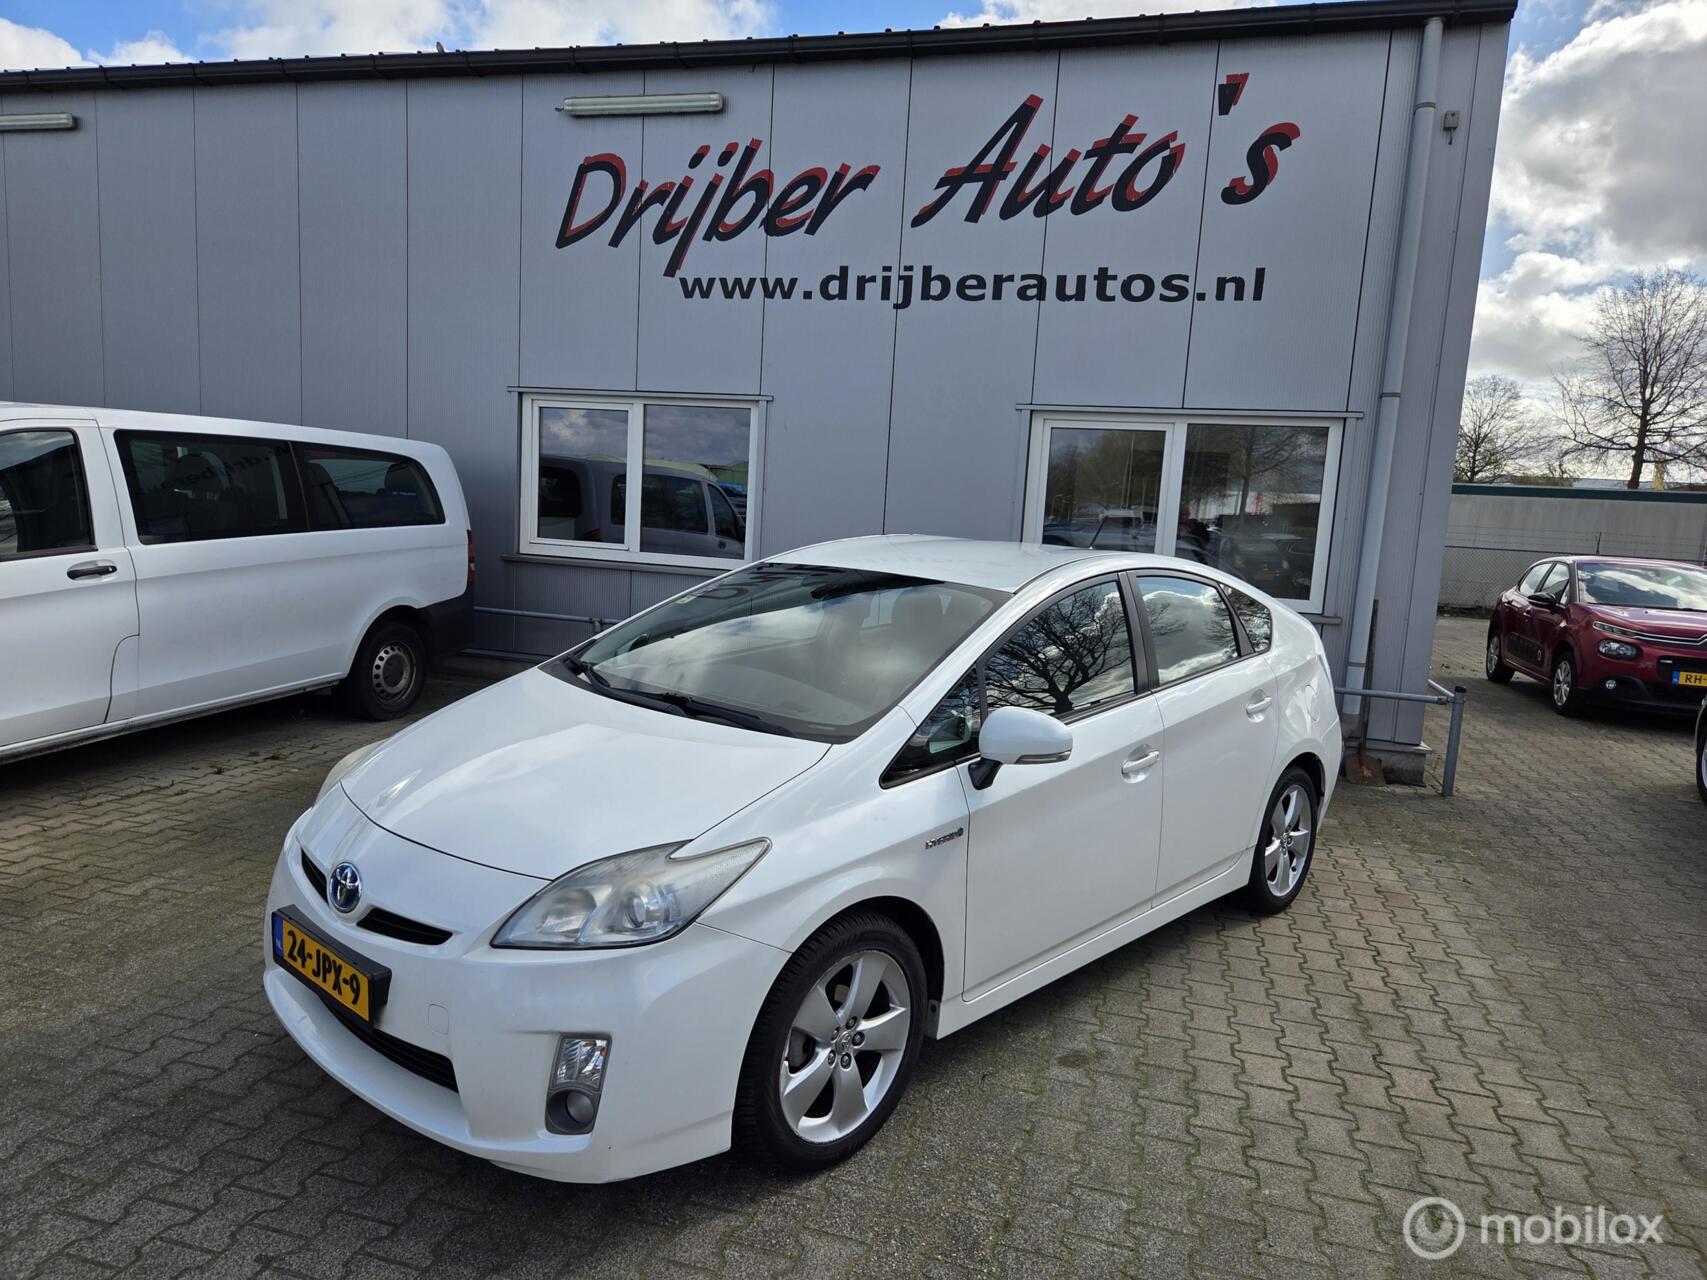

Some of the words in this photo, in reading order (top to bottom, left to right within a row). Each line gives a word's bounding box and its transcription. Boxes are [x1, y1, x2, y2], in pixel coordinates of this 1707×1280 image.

[556, 138, 881, 277] Drijber
[910, 72, 1301, 228] Auto's
[680, 265, 1266, 310] www.drijberautos.nl
[287, 929, 361, 1005] 24-JPX-9
